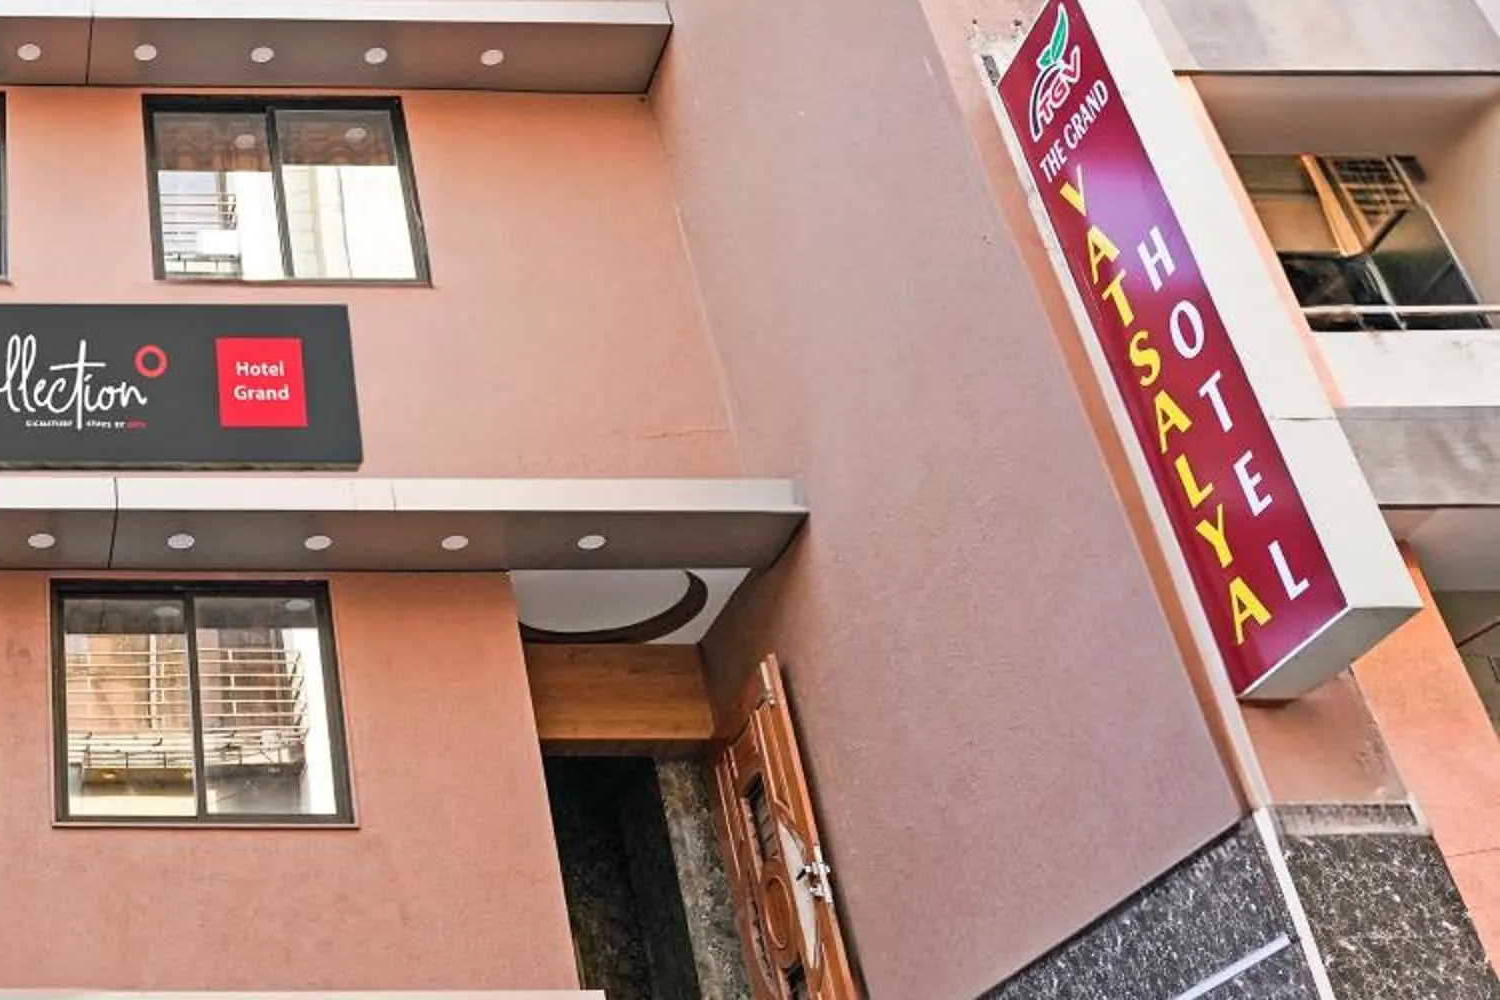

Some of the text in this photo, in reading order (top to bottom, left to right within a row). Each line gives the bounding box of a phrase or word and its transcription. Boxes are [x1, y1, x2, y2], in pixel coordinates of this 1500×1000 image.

[1039, 79, 1109, 183] THE GRAND
[233, 383, 290, 401] Grand
[235, 360, 285, 377] Hotel
[1060, 164, 1272, 645] VATSALYA
[1136, 225, 1310, 601] HOTEL
